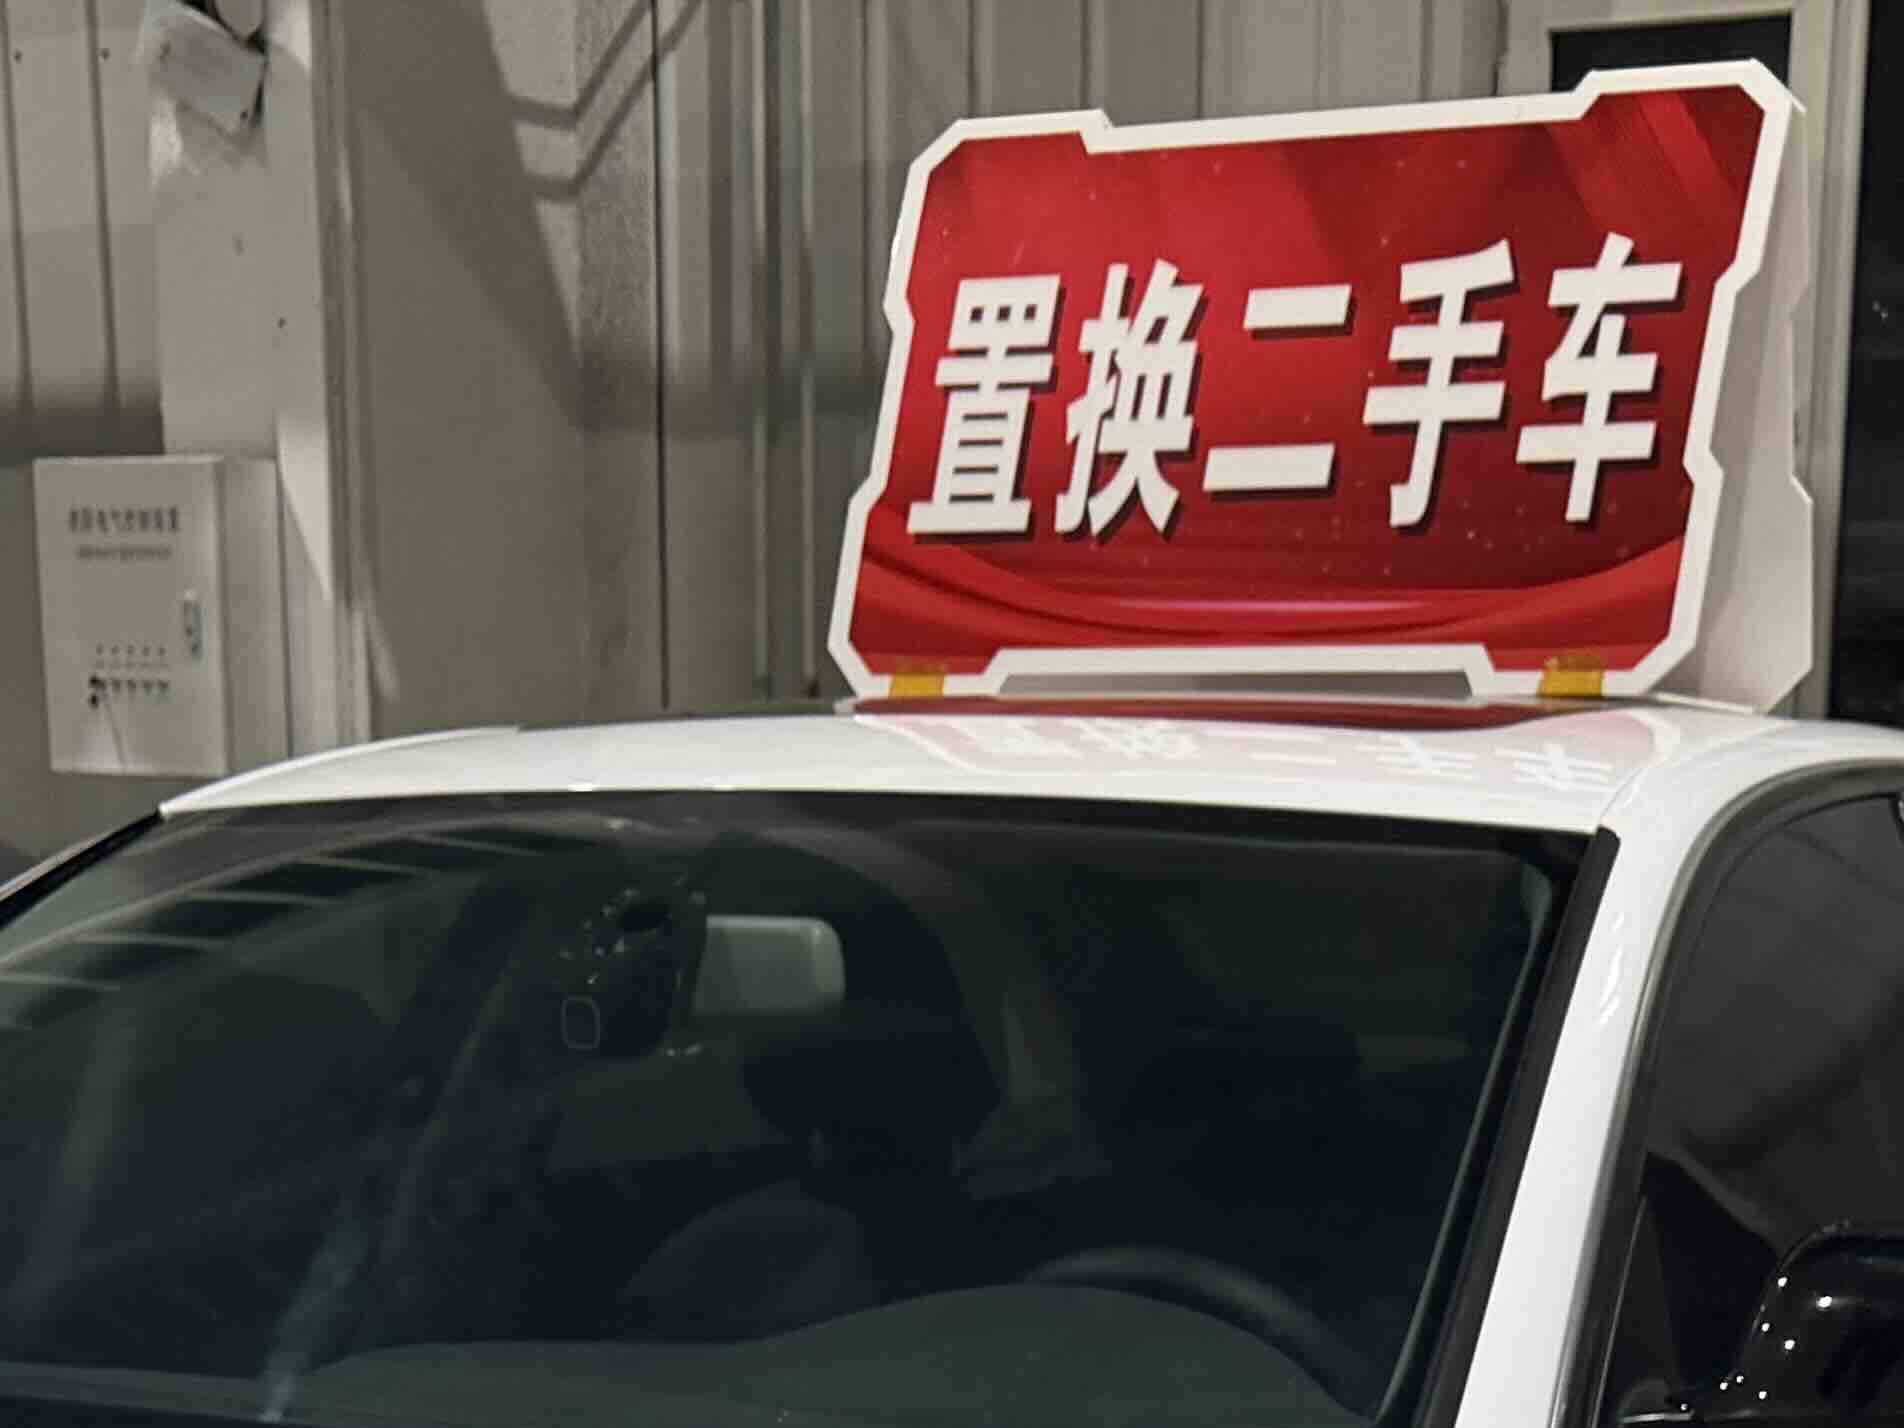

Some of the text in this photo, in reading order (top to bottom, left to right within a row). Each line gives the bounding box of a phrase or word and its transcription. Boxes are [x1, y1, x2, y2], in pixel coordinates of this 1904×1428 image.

[905, 231, 1683, 535] 置换二手车
